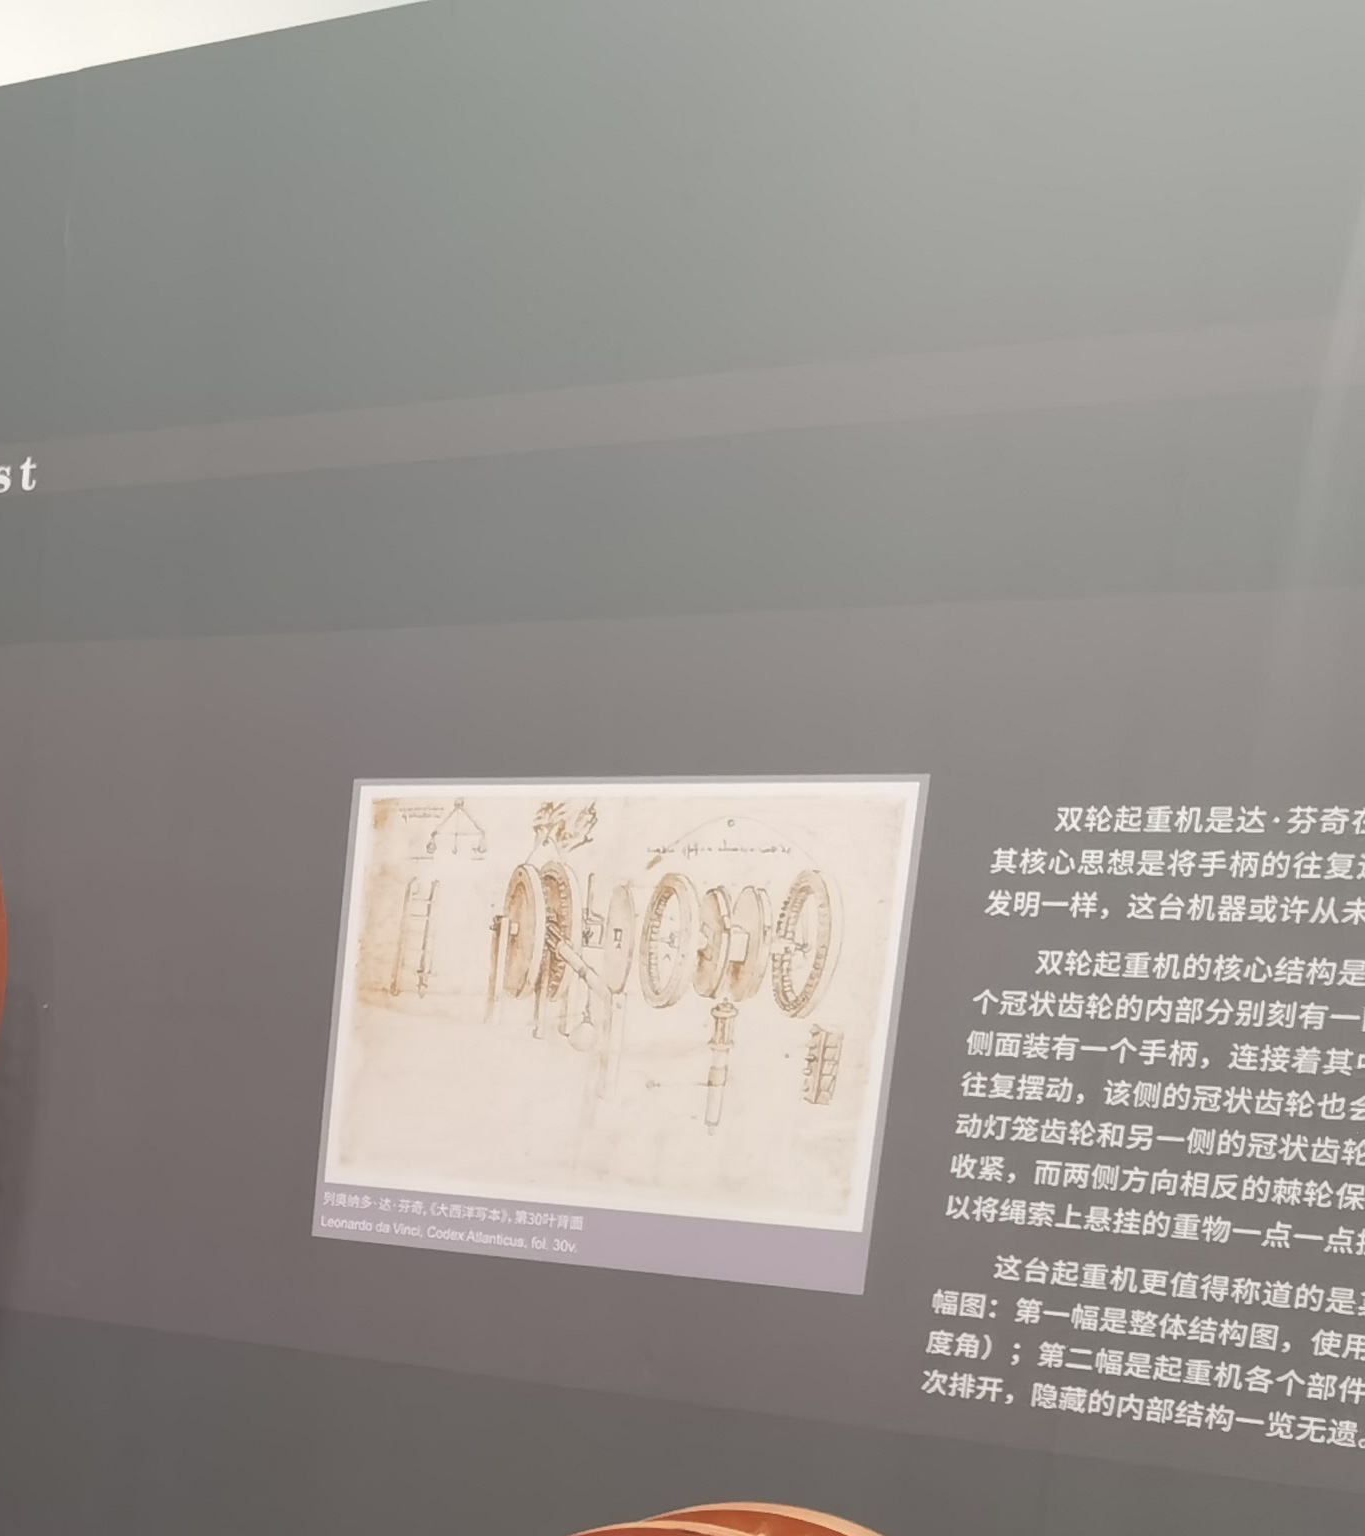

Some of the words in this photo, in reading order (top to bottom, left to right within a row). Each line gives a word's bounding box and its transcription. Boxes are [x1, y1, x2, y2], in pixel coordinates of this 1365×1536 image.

[990, 848, 1365, 879] 其核心思想是将手柄的往复
[1035, 950, 1365, 986] 双轮起重机的核心结构是
[973, 989, 1365, 1031] 个冠状齿轮的内部分别刻有一
[955, 1113, 1365, 1166] 动灯笼齿轮和另一侧的冠状齿轮
[320, 1215, 372, 1233] Leonardo
[375, 1221, 390, 1234] da
[427, 1226, 465, 1242] Codex
[993, 1255, 1365, 1315] 这台起重机更值得称道的是
